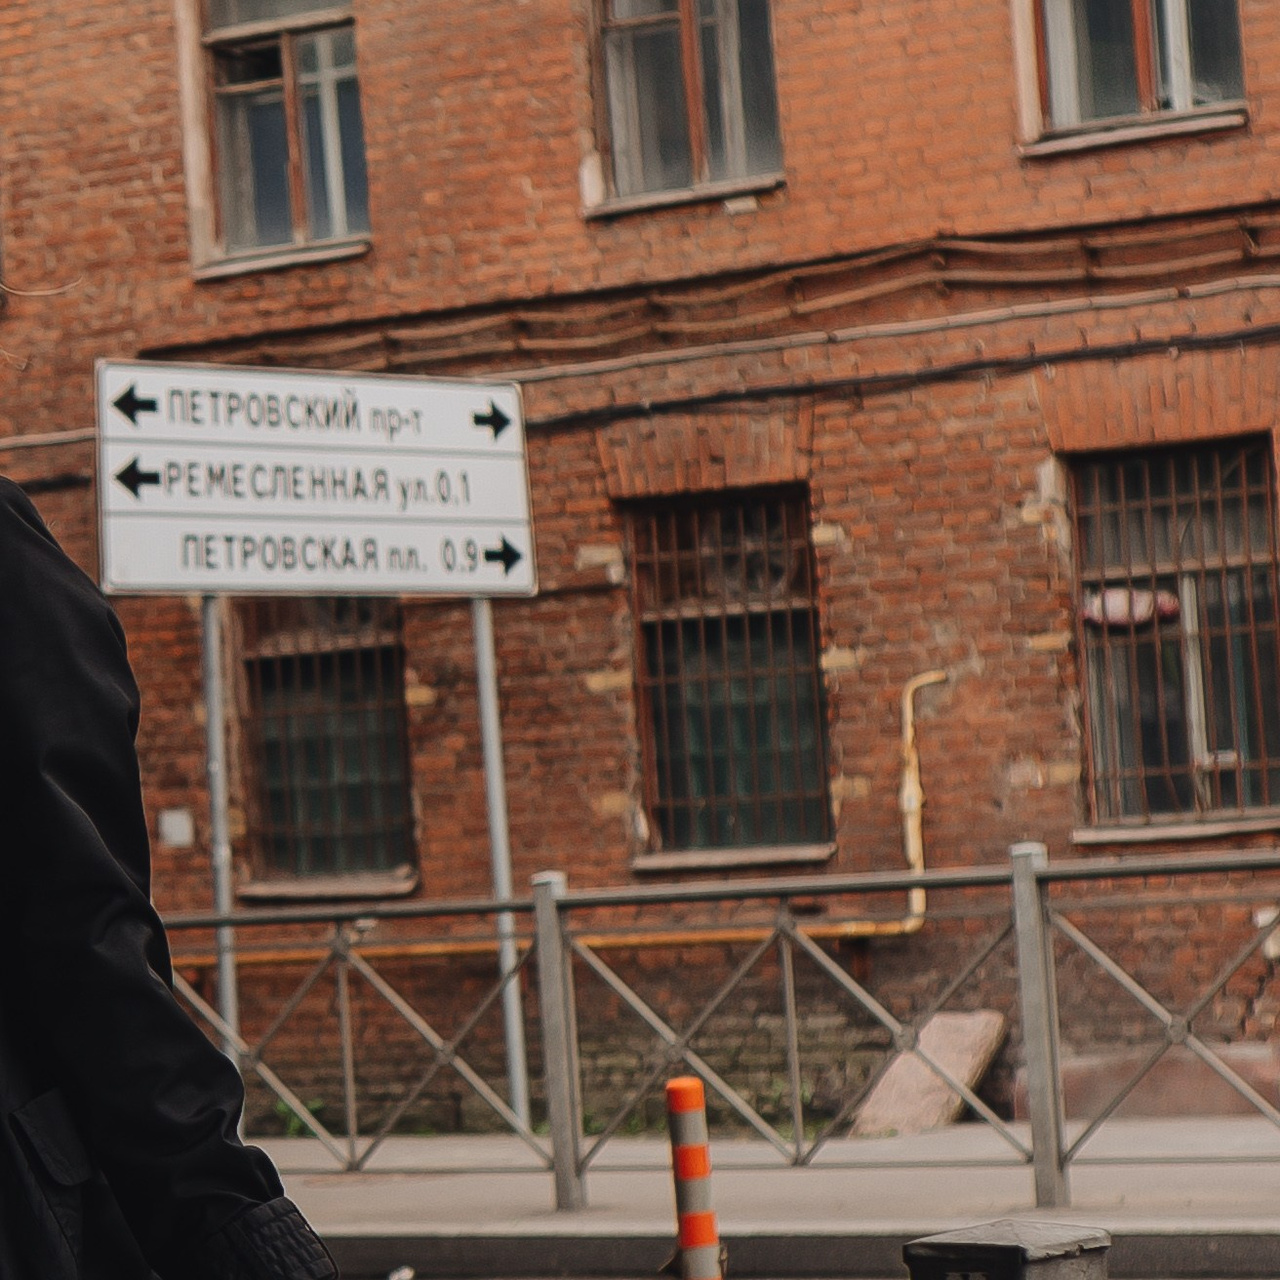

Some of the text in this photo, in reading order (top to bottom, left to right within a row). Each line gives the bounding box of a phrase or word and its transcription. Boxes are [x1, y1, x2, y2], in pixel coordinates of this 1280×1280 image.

[168, 388, 422, 441] ПЕТРОВСКИЙ пр-т
[166, 461, 390, 502] РЕМЕСЛЕННАЯ
[181, 533, 479, 572] ПЕТРОВСКАЯ пл. 0.9
